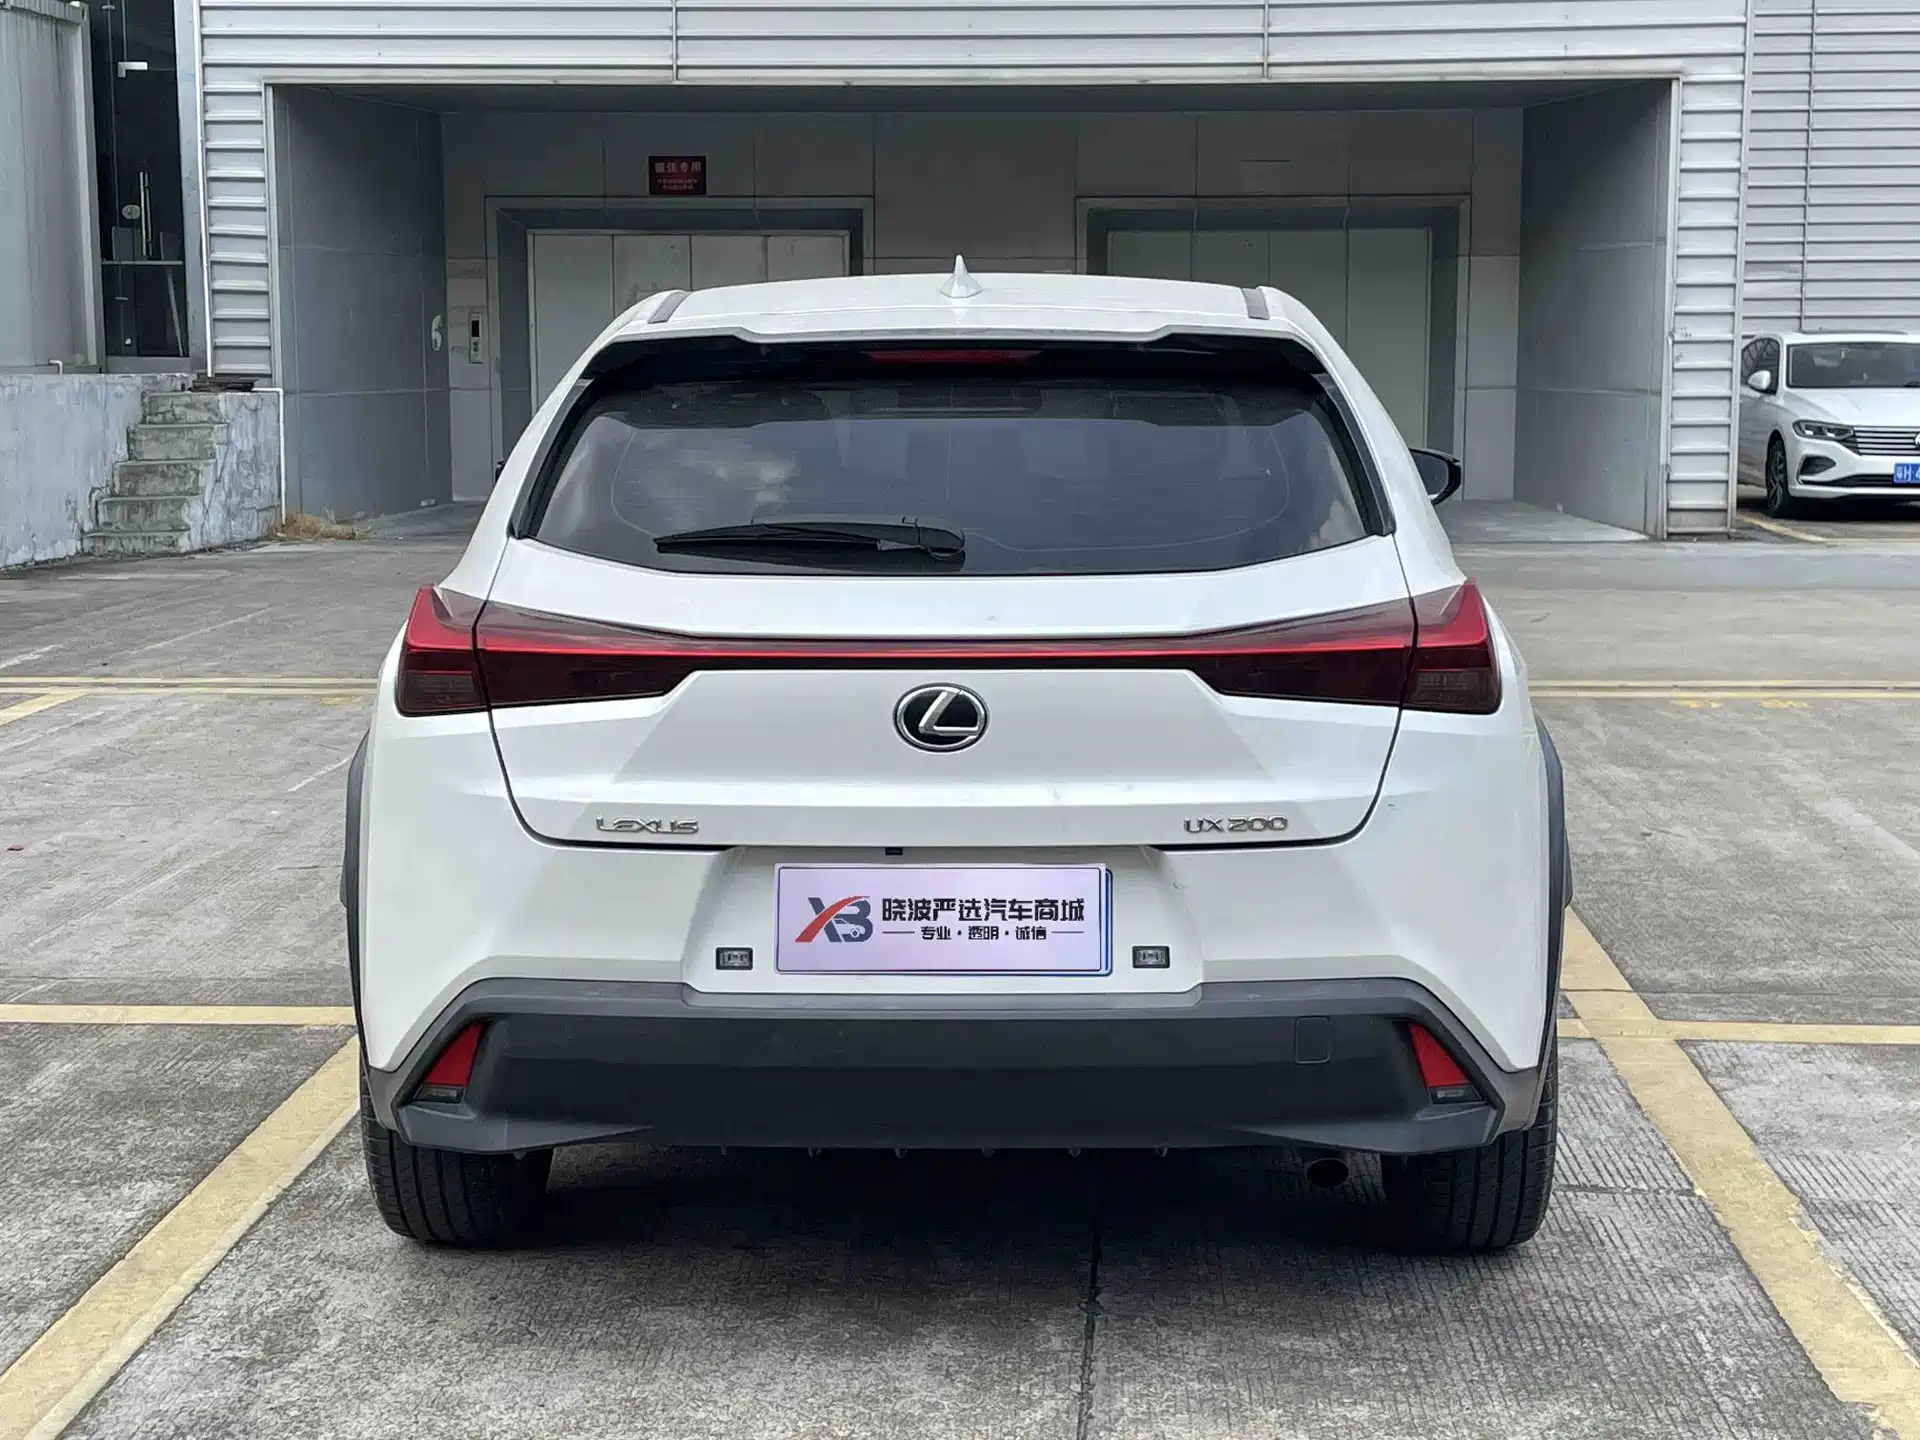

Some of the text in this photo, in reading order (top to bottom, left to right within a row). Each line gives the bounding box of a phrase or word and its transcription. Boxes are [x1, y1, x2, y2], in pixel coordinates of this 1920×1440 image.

[596, 816, 699, 834] LEXUS
[881, 898, 1085, 921] 晓波严选汽车商城
